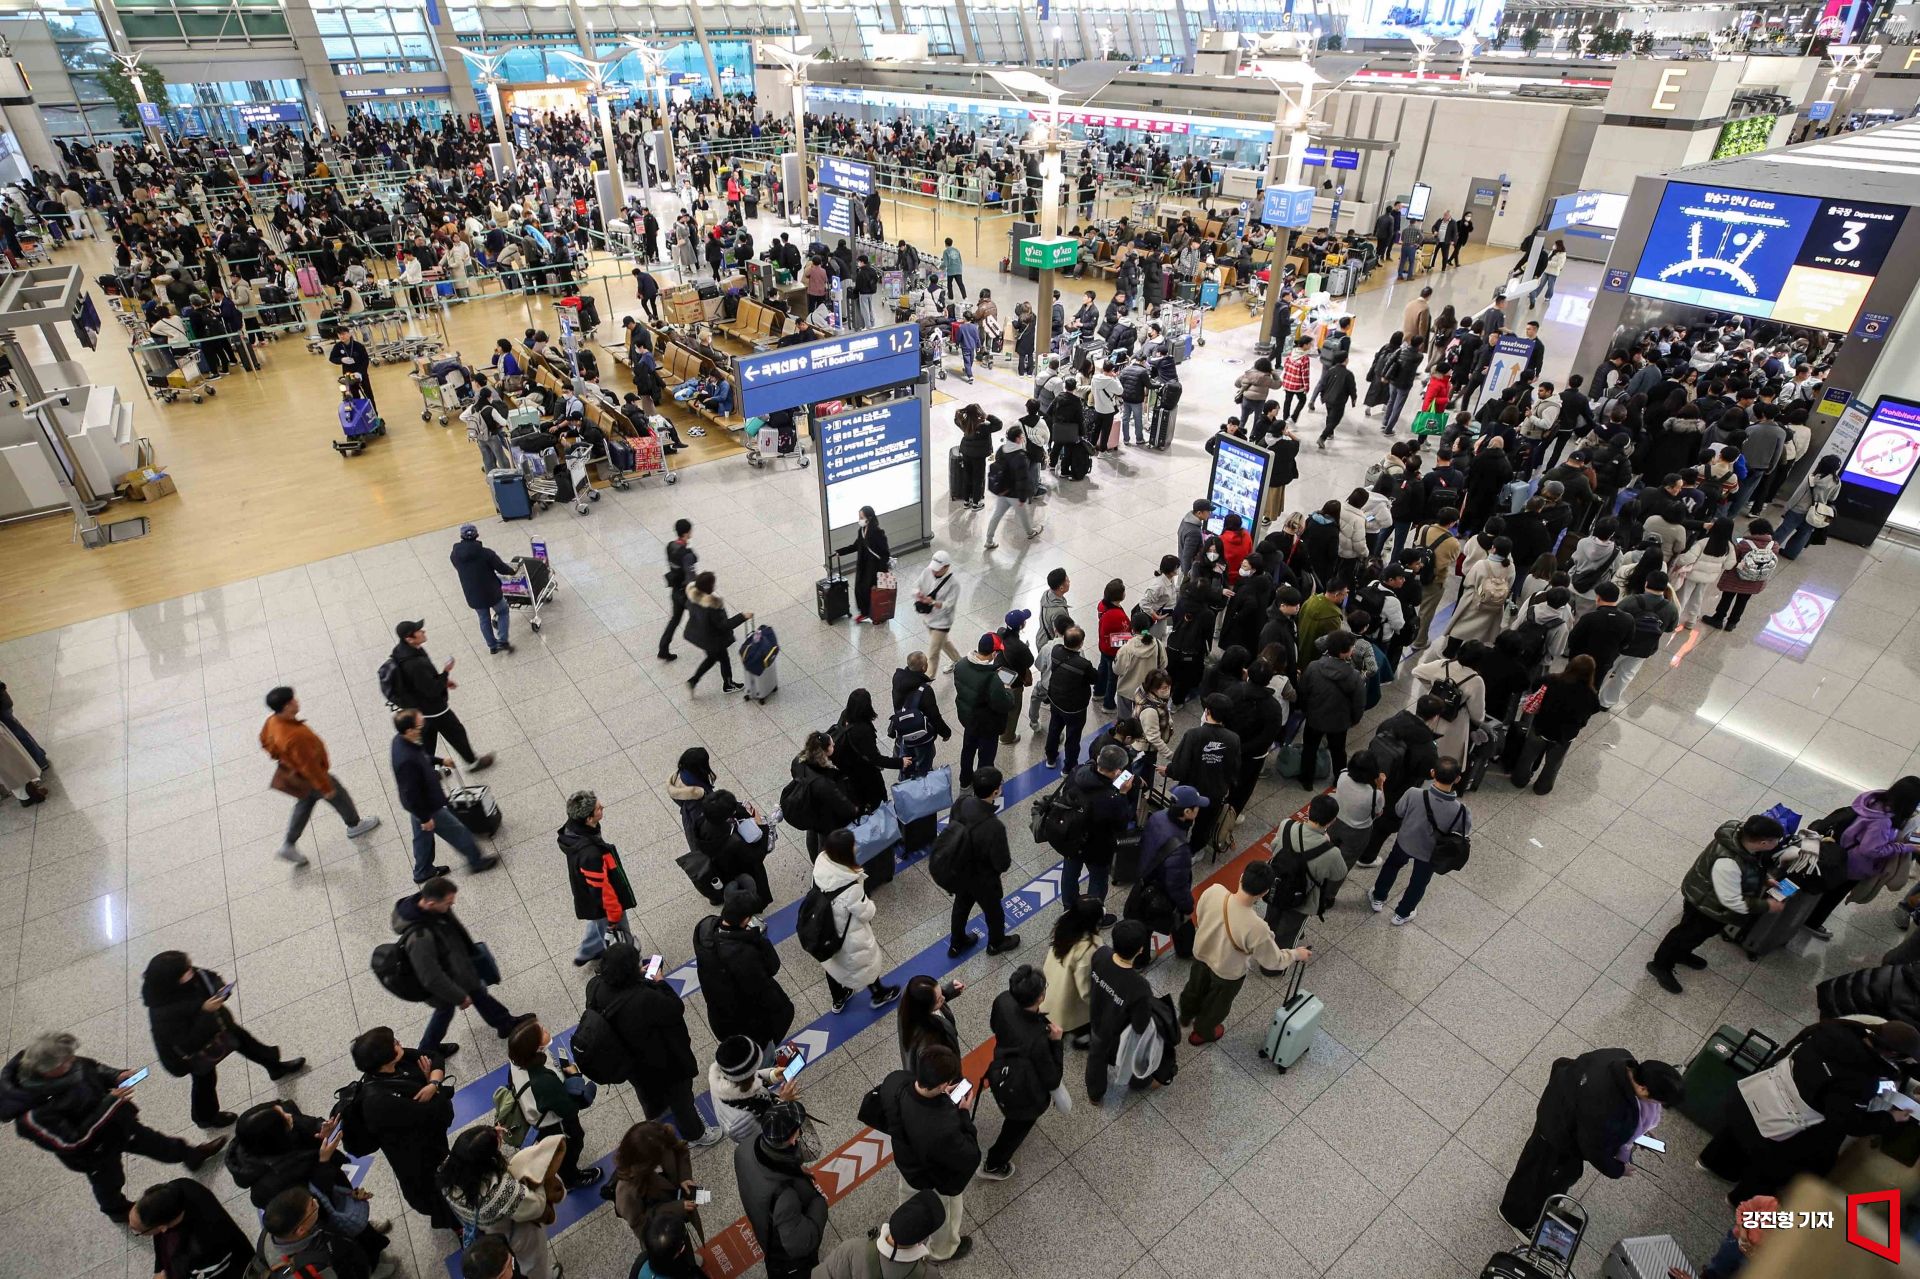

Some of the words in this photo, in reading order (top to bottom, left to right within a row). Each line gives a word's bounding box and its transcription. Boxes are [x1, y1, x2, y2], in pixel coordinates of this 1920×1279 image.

[1203, 33, 1211, 48] F
[1651, 68, 1688, 111] E
[1271, 195, 1288, 209] 카트
[1705, 192, 1730, 204] 탑승구
[1730, 195, 1749, 207] 안내
[1749, 199, 1775, 210] Gates
[1268, 209, 1286, 217] CARTS
[1828, 206, 1852, 217] 출국장
[1854, 211, 1882, 220] Departure
[1832, 220, 1867, 252] 3
[1061, 247, 1072, 255] AED
[1834, 257, 1847, 266] 07
[1847, 259, 1860, 268] 48
[829, 351, 864, 366] Boarding
[1881, 407, 1916, 420] Prohibited
[1005, 900, 1025, 919] 대기선
[1011, 895, 1033, 913] 출국장
